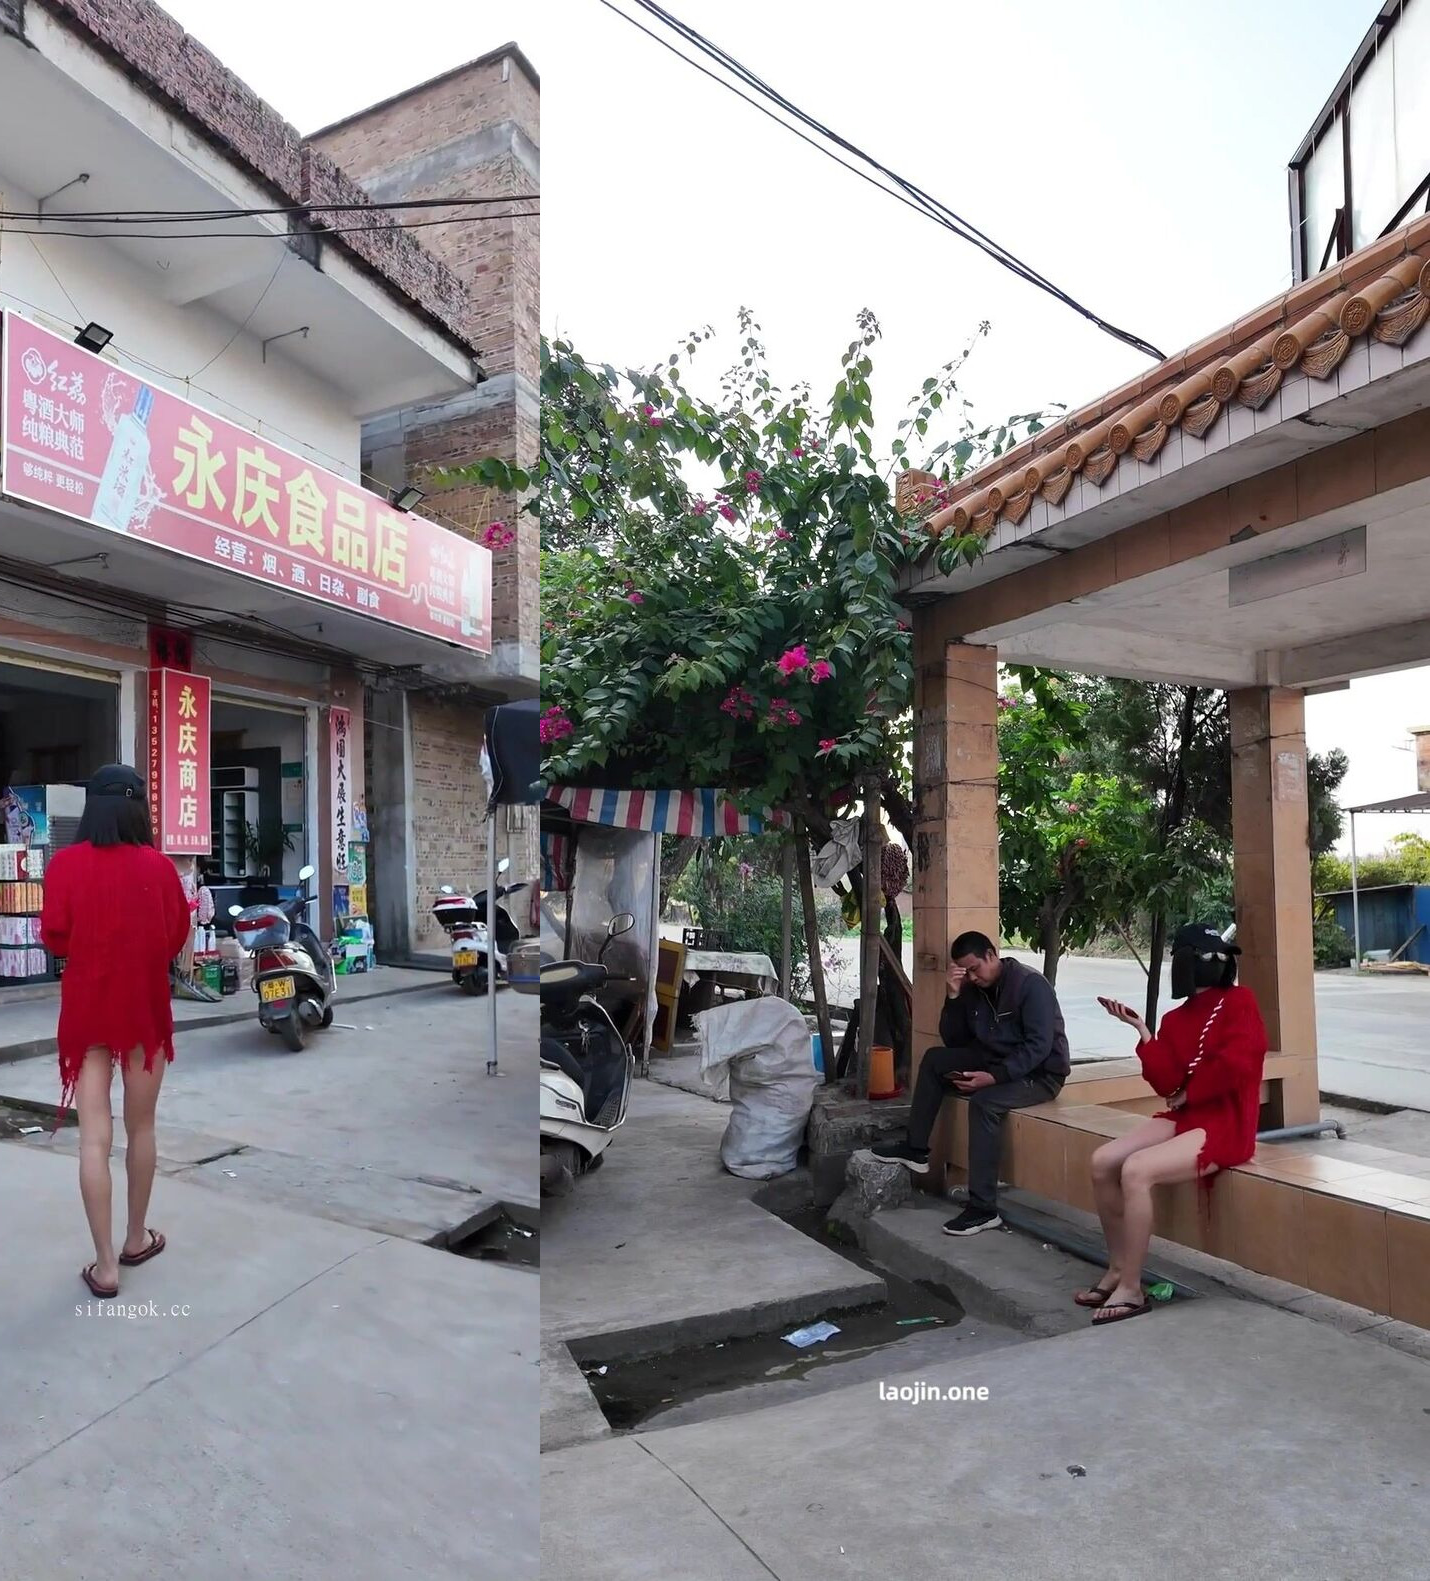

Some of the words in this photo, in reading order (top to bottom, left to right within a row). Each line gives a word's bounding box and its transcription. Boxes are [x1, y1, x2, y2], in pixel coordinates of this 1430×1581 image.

[21, 415, 85, 461] 纯粮典范
[22, 388, 85, 435] 粤酒大师
[172, 414, 409, 589] 永庆食品店
[178, 685, 198, 828] 永庆商店
